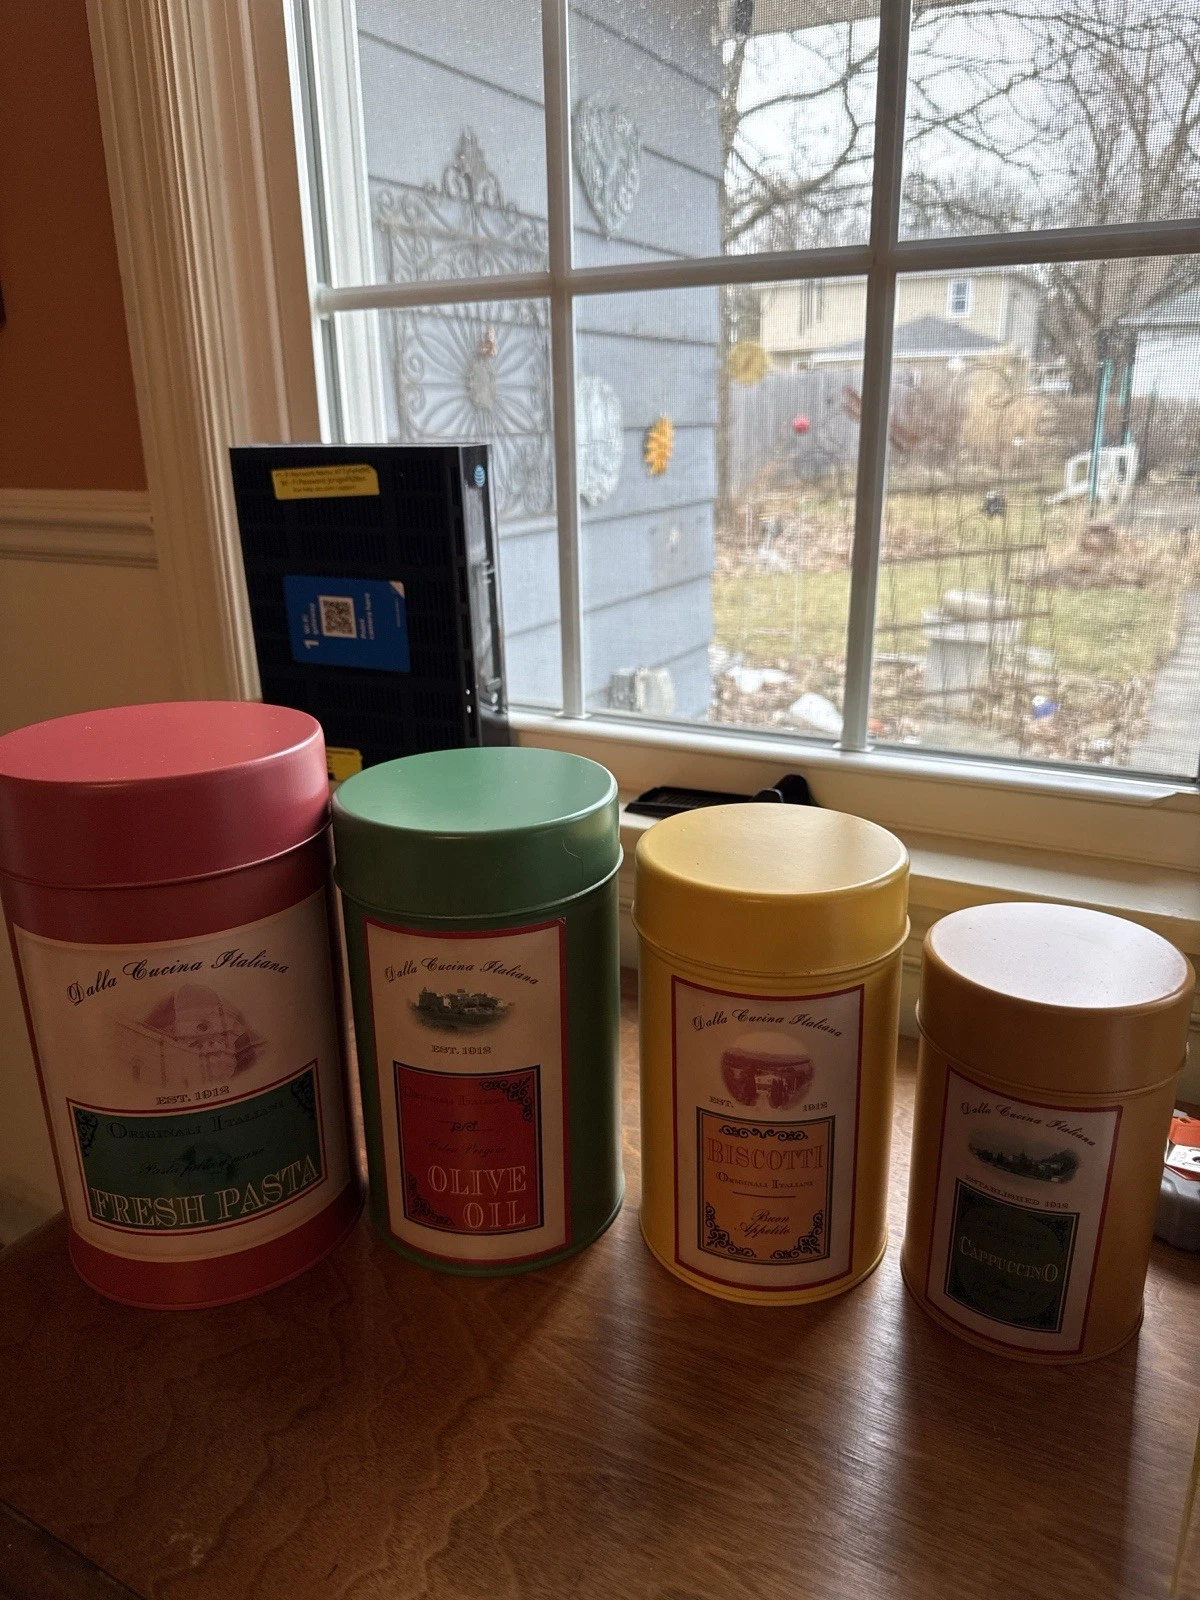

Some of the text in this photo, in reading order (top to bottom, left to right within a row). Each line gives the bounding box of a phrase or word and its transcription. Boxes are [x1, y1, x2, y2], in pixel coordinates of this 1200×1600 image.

[67, 948, 289, 1007] Dalla Cucina Italiana
[384, 956, 540, 985] Dalla Cucina Italiana
[692, 1008, 843, 1038] Dalla Cucina Italiana
[431, 1044, 459, 1055] EST.
[156, 1085, 230, 1106] EST. 1912
[708, 1096, 734, 1108] EST.
[961, 1101, 1096, 1146] Dalla Cucina Italiana
[706, 1136, 824, 1171] BISCOTTI
[90, 1154, 321, 1228] FRESH PASTA
[427, 1165, 527, 1195] OLIVE
[462, 1200, 526, 1229] OIL
[751, 1208, 789, 1223] Buon
[959, 1235, 1059, 1283] CAPPUCCINO
